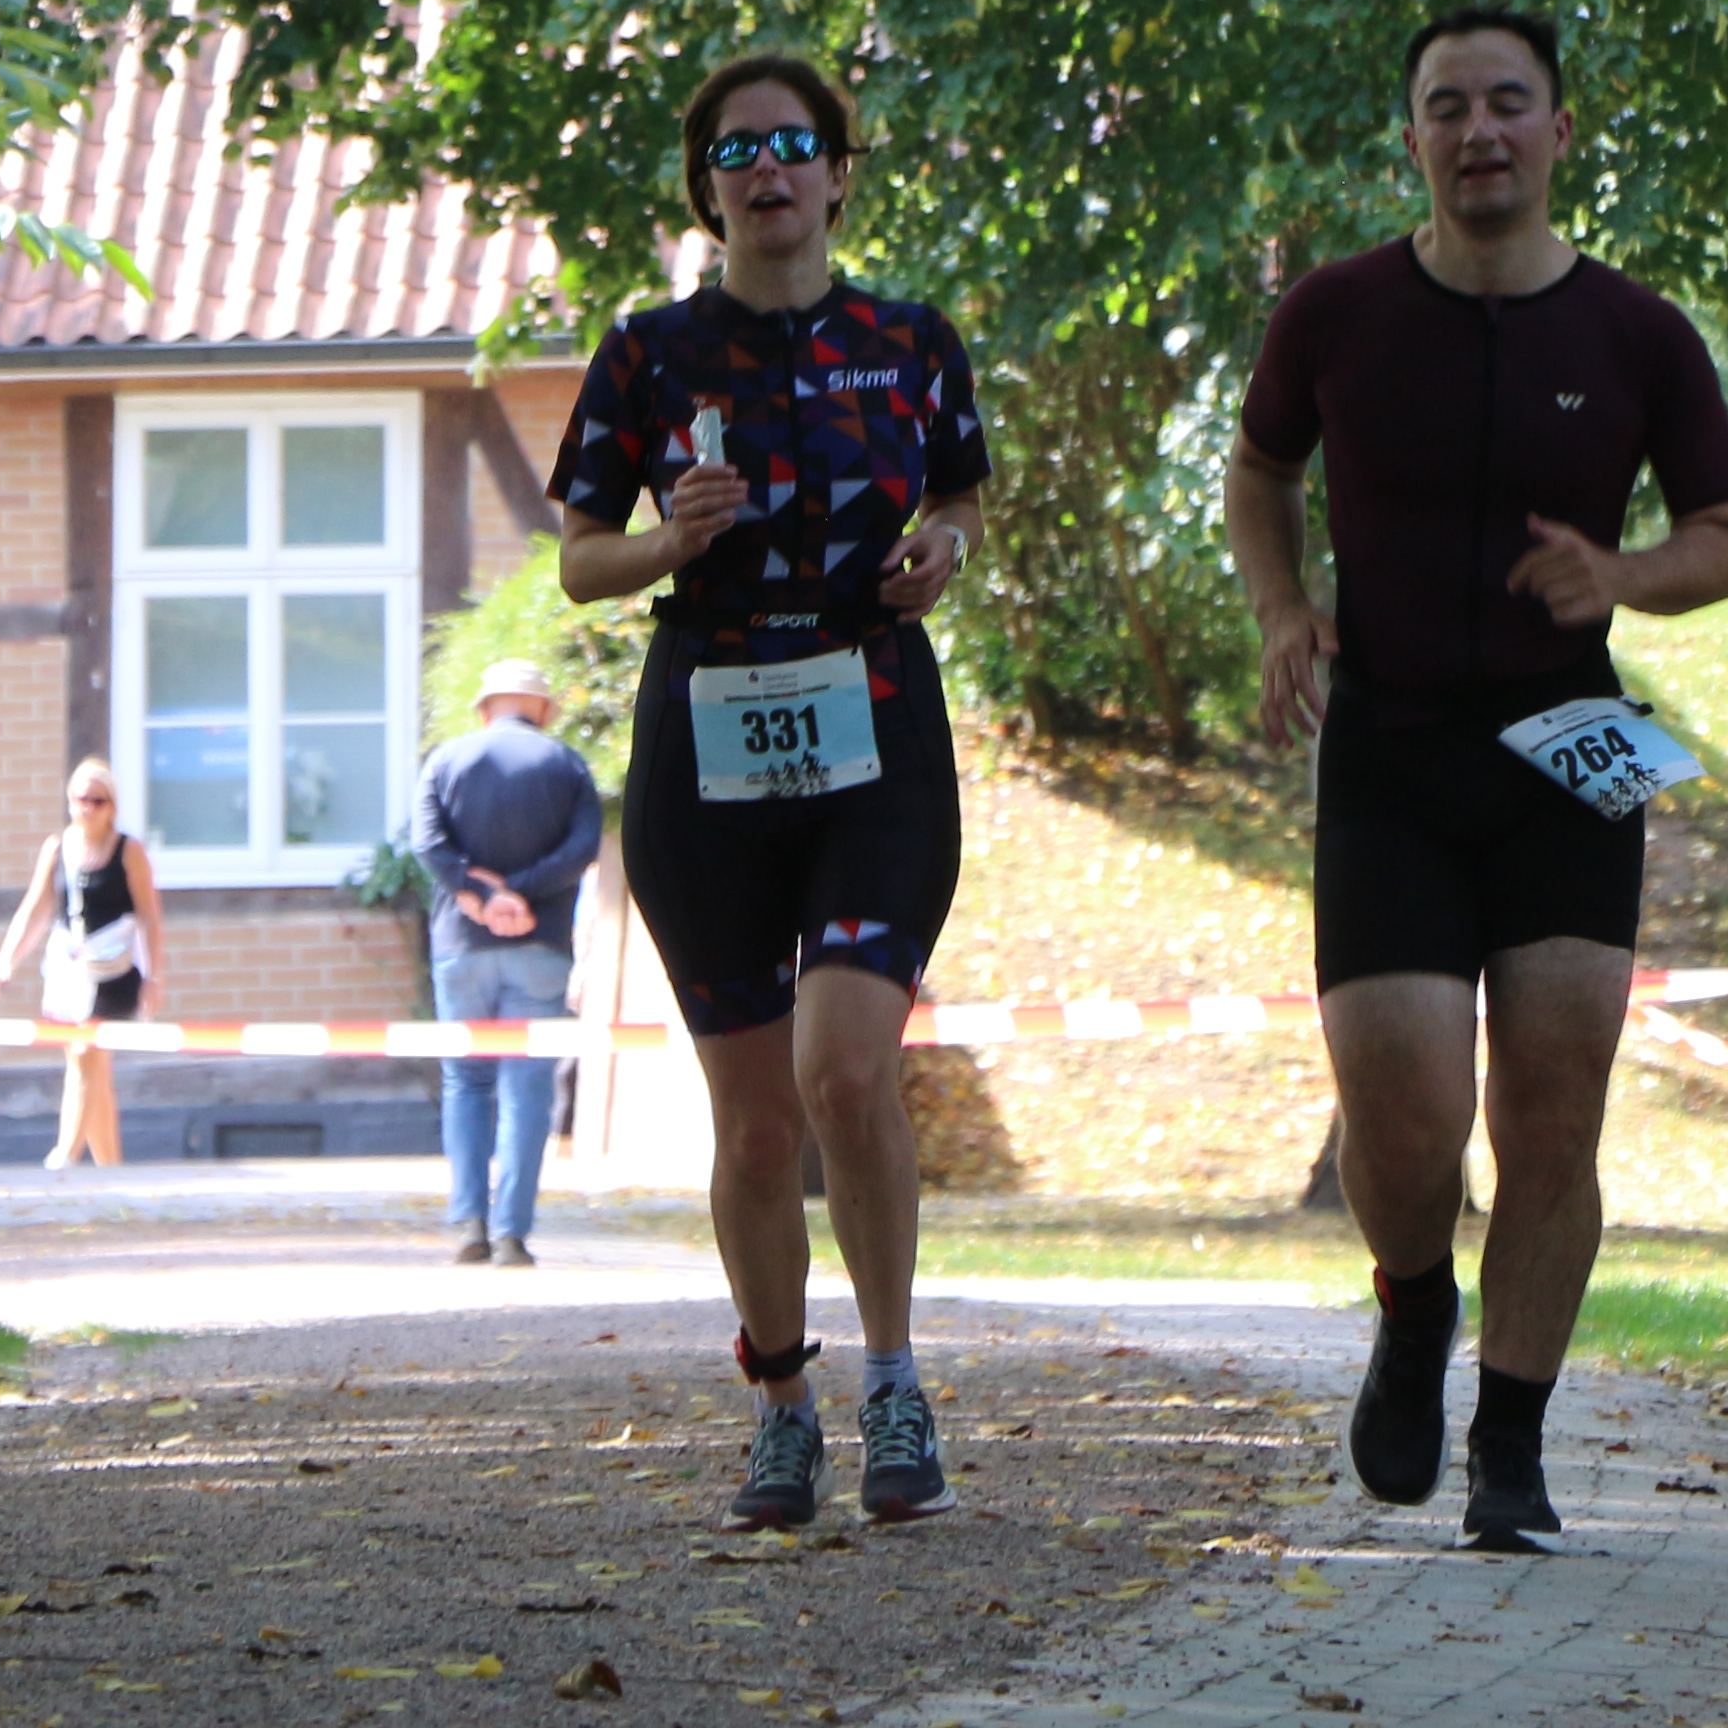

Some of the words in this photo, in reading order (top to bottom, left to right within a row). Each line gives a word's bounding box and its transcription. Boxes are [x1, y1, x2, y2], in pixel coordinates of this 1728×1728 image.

[828, 368, 899, 393] Sikma
[741, 704, 820, 755] 331
[1551, 726, 1637, 792] 264
